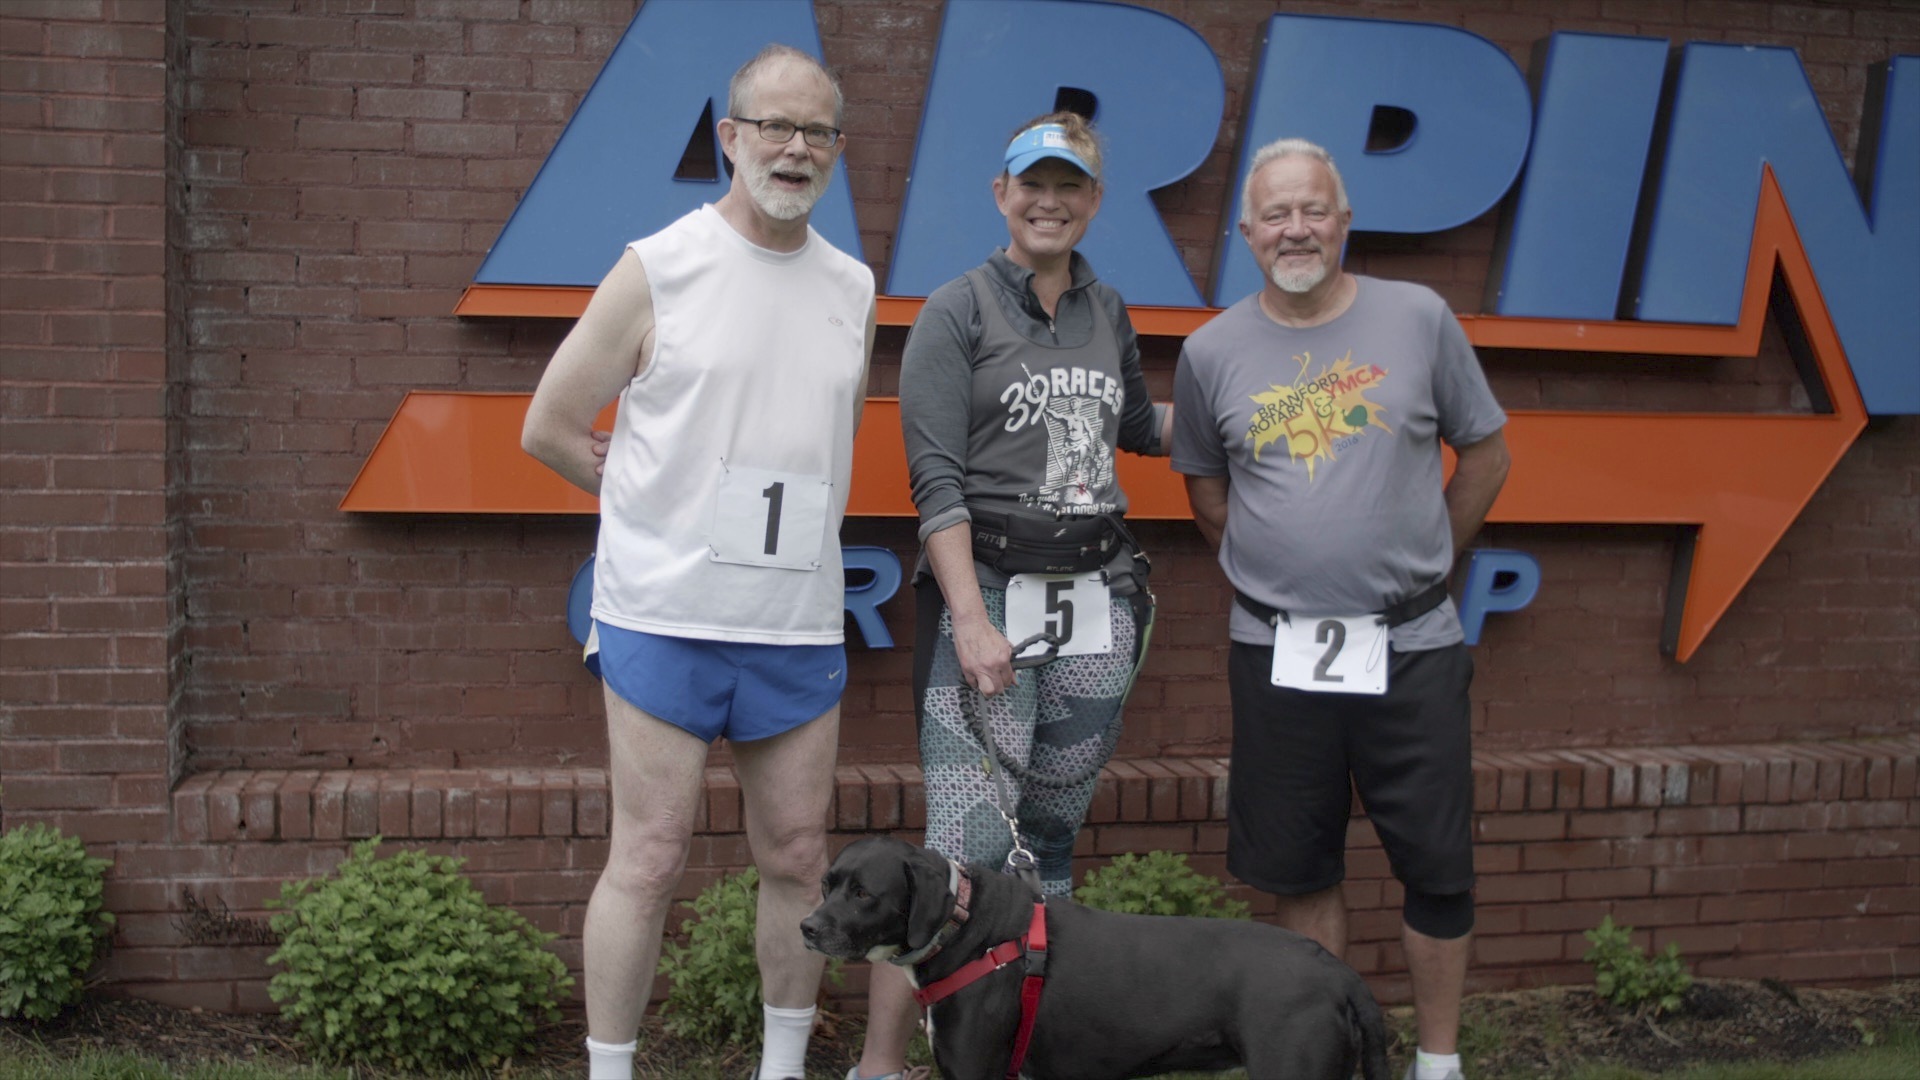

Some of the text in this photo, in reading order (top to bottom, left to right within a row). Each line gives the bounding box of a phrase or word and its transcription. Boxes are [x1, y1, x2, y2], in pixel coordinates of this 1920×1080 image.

[475, 0, 1920, 415] ARPIN
[1000, 367, 1123, 433] 39 RACES
[1248, 400, 1306, 438] ROTARY
[1322, 363, 1386, 400] YMCA
[1257, 372, 1340, 421] BRANFORD
[1283, 397, 1351, 459] 5K
[762, 481, 785, 556] 1
[1044, 580, 1075, 646] 5
[1312, 619, 1347, 683] 2
